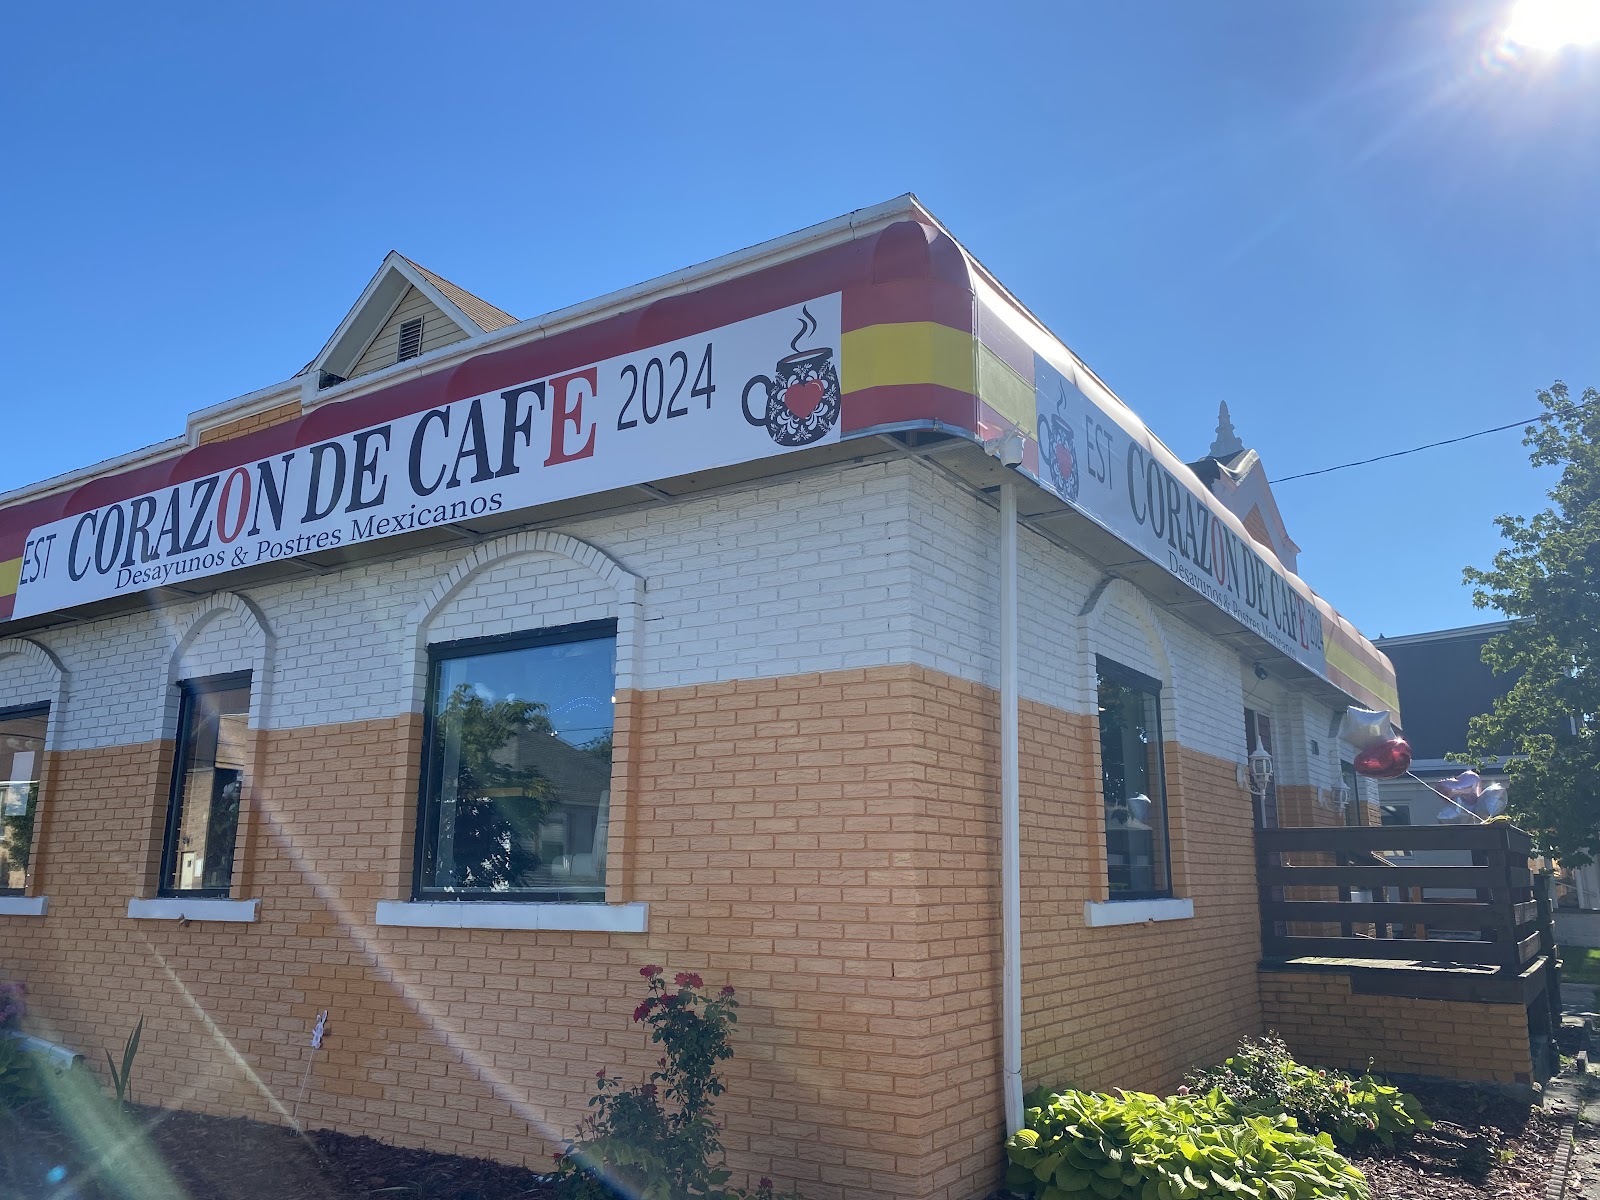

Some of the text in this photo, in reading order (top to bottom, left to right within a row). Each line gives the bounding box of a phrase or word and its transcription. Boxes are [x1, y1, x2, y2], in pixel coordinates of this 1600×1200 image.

[20, 342, 716, 586] EST CORAZON DE CAFE 2024
[115, 492, 503, 590] Desayunos & Postres Mexicanos
[1085, 414, 1114, 490] EST
[1127, 440, 1240, 600] CORAZON
[1241, 542, 1269, 621] DE
[1270, 570, 1309, 651] CAFE
[1168, 549, 1223, 607] Desayunos
